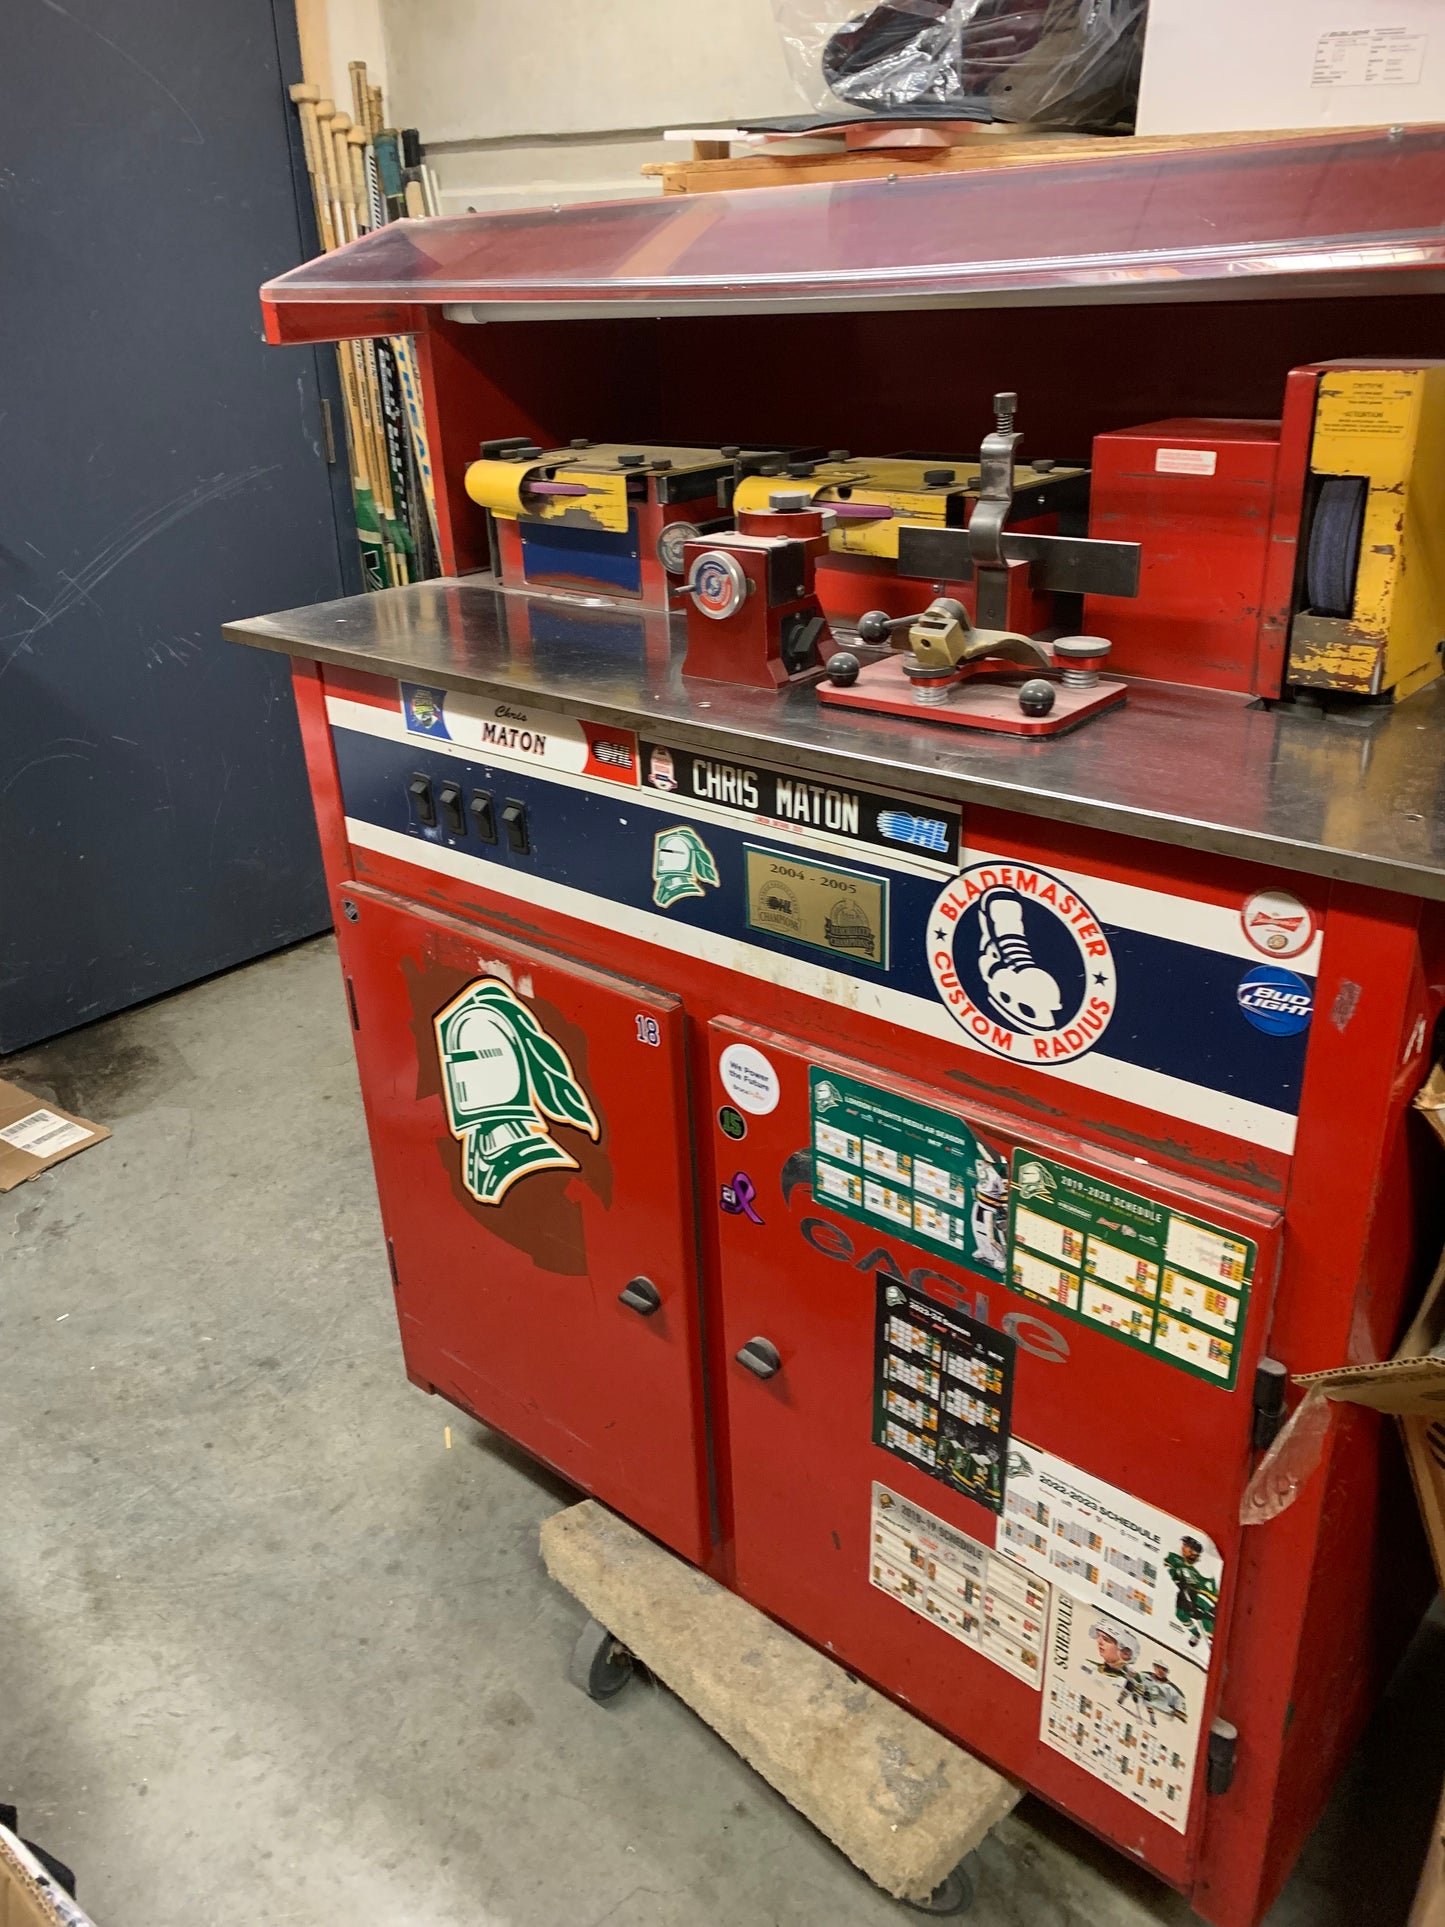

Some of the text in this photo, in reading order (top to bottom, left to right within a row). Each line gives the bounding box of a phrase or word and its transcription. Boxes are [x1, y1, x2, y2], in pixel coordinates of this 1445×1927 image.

[494, 705, 528, 722] Chris
[481, 722, 547, 755] MATON
[693, 758, 859, 834] CHRIS MATON
[876, 810, 949, 853] OHL
[770, 863, 805, 880] 2004
[820, 877, 857, 893] 2005
[939, 868, 1109, 959] BLADEMASTER
[933, 951, 1110, 1058] CUSTOM RADIUS
[1240, 995, 1314, 1016] LIGHT
[1253, 987, 1311, 1005] BUD
[635, 1014, 661, 1047] 18
[729, 1070, 769, 1091] the Future
[730, 1061, 769, 1081] We Power
[722, 1110, 742, 1136] 15
[1113, 1197, 1162, 1223] SCHEDULE
[1099, 1506, 1161, 1544] SCHEDULE
[939, 1527, 984, 1560] SCHEDULE
[1054, 1594, 1073, 1670] SCHEDULE
